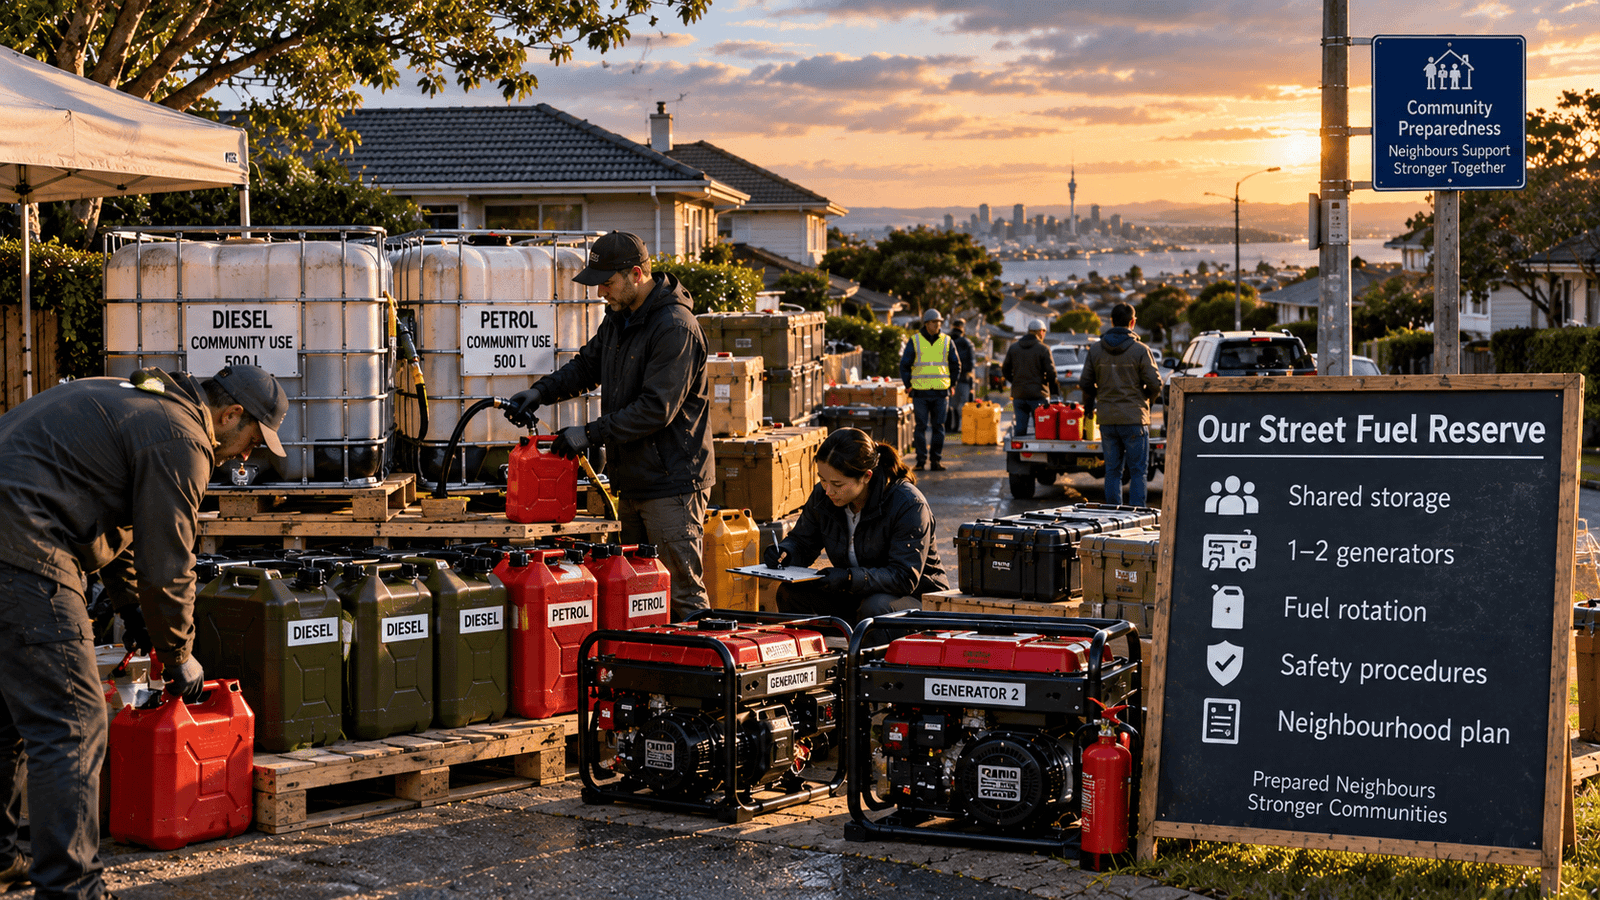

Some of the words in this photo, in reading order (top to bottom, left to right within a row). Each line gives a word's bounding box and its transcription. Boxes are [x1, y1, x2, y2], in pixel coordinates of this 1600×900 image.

[1408, 100, 1492, 118] Community
[1399, 120, 1501, 140] Preparedness
[1389, 145, 1458, 160] Neighbours
[1463, 144, 1510, 159] Support
[1394, 162, 1447, 177] Stronger
[1452, 161, 1506, 177] Together
[213, 310, 272, 329] DIESEL
[481, 311, 538, 328] PETROL
[191, 336, 265, 349] COMMUNITY
[270, 336, 292, 348] USE
[467, 336, 529, 348] COMMUNITY
[532, 335, 551, 348] USE
[254, 355, 261, 368] L
[494, 354, 516, 368] 500
[520, 354, 526, 368] L
[1199, 415, 1250, 442] Our
[1259, 415, 1346, 443] Street
[1357, 414, 1417, 443] Fuel
[1429, 415, 1545, 443] Reserve
[1289, 485, 1362, 506] Shared
[1371, 488, 1450, 513] storage
[1337, 544, 1454, 567] generators
[552, 605, 589, 622] PETROL
[632, 597, 665, 612] PETROL
[1285, 596, 1329, 618] Fuel
[1339, 600, 1426, 622] rotation
[387, 620, 424, 637] DIESEL
[464, 611, 500, 628] DIESEL
[294, 623, 333, 640] DIESEL
[1281, 653, 1352, 683] Safety
[1361, 659, 1487, 684] procedures
[770, 671, 809, 689] GENERATOR
[931, 683, 1007, 700] GENERATOR
[1011, 688, 1019, 701] 2
[1279, 710, 1451, 741] Neighbourhood
[1461, 720, 1509, 747] plan
[1253, 770, 1329, 793] Prepared
[1336, 775, 1436, 799] Neighbours
[1248, 794, 1323, 819] Stronger
[1329, 799, 1447, 824] Communities
